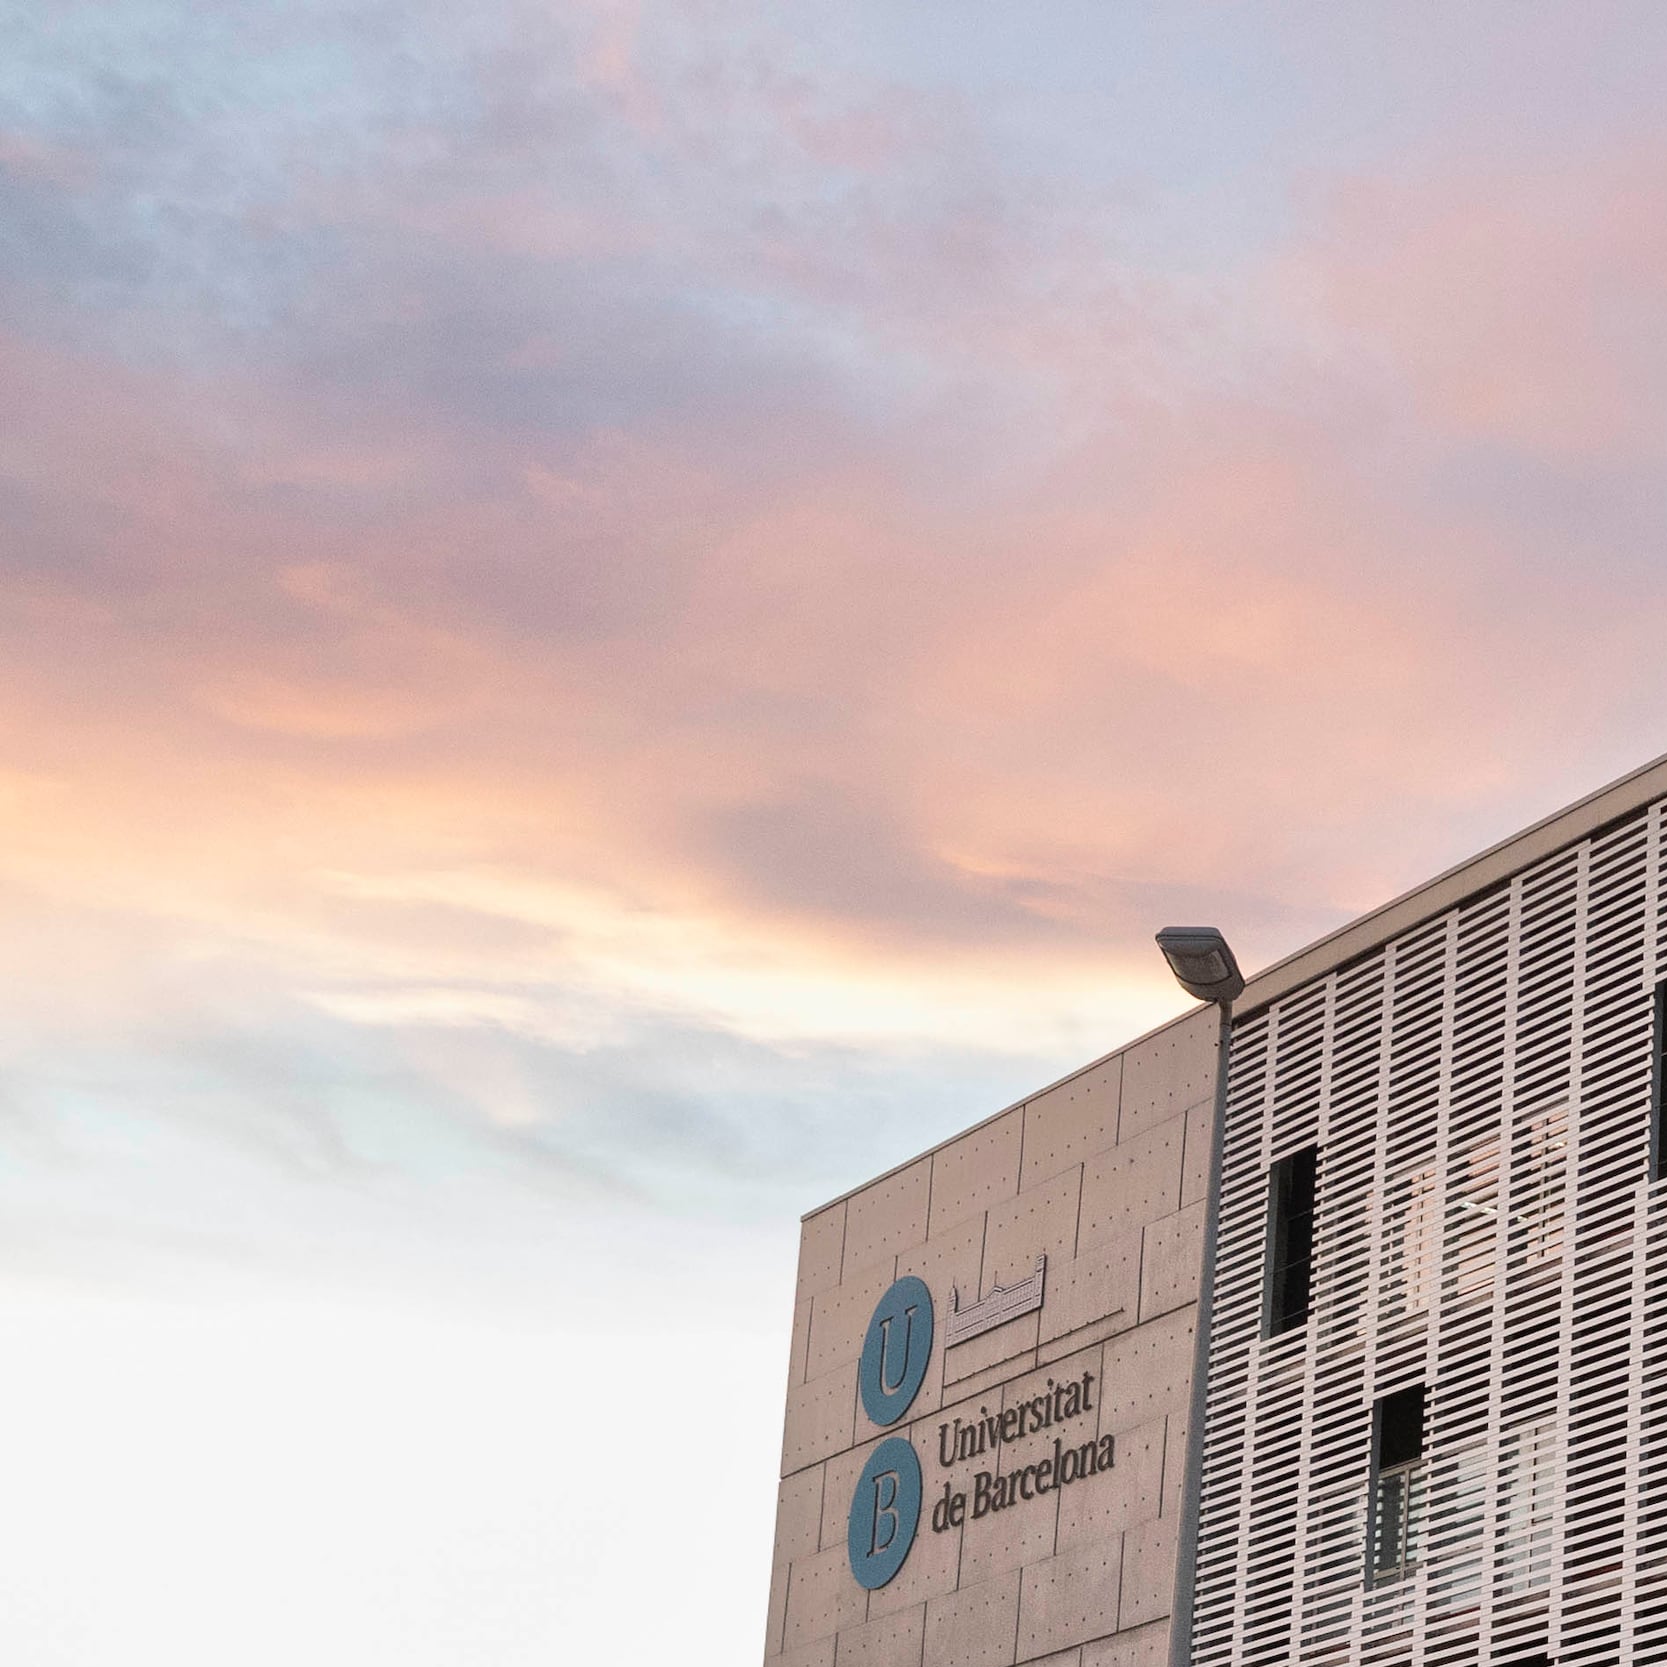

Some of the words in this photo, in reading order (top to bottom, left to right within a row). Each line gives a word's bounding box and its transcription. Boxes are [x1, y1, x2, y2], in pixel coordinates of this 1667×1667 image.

[879, 1305, 919, 1397] U
[938, 1371, 1094, 1467] Universitat
[866, 1470, 899, 1558] B
[932, 1482, 967, 1533] de
[970, 1433, 1115, 1519] Barcelona
